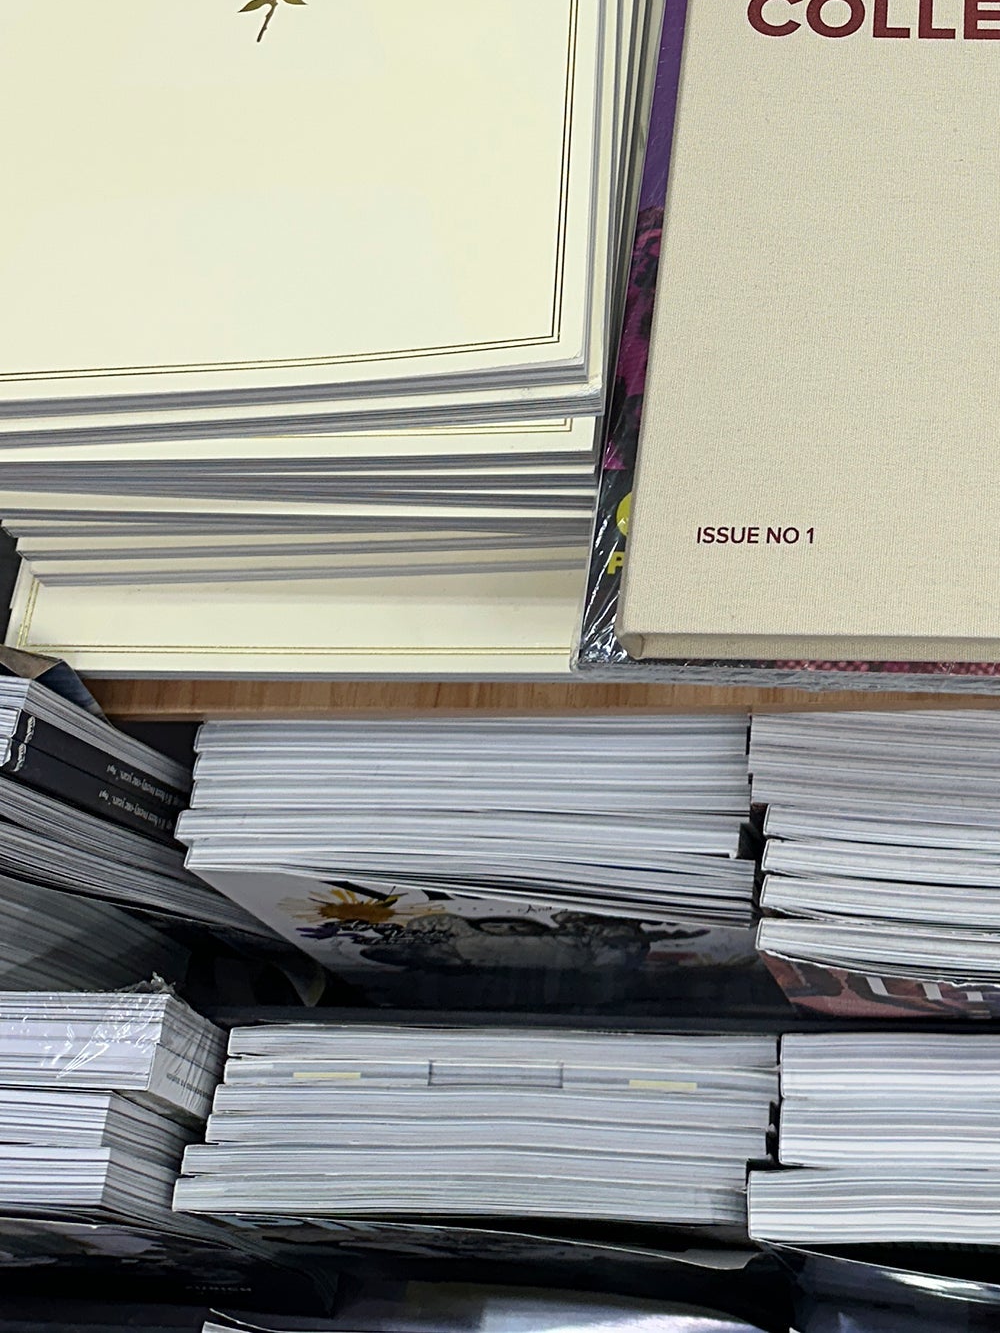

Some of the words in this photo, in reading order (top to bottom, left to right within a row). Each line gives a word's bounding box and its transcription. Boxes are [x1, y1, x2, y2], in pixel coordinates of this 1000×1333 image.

[696, 527, 760, 546] ISSUE
[765, 527, 801, 545] NO
[806, 527, 816, 545] 1
